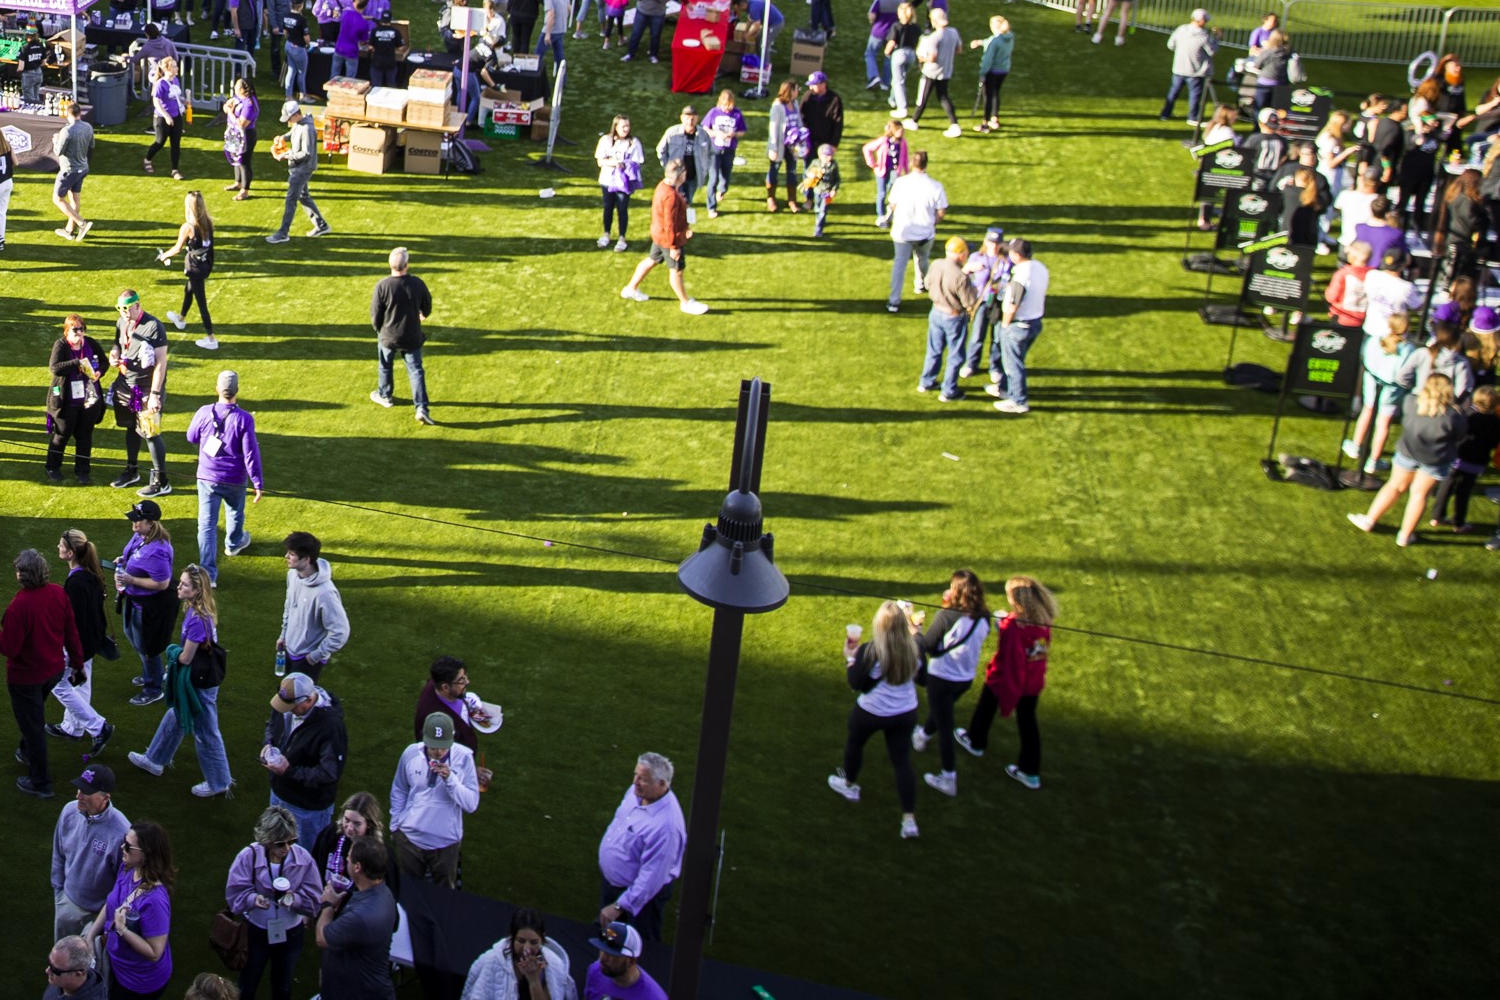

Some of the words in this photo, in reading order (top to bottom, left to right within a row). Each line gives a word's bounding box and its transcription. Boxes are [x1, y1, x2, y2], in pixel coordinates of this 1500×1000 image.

[5, 134, 28, 147] CBC
[408, 147, 439, 156] COSTCO
[1307, 357, 1340, 372] ENTER
[1308, 370, 1335, 383] HERE
[435, 726, 443, 738] B
